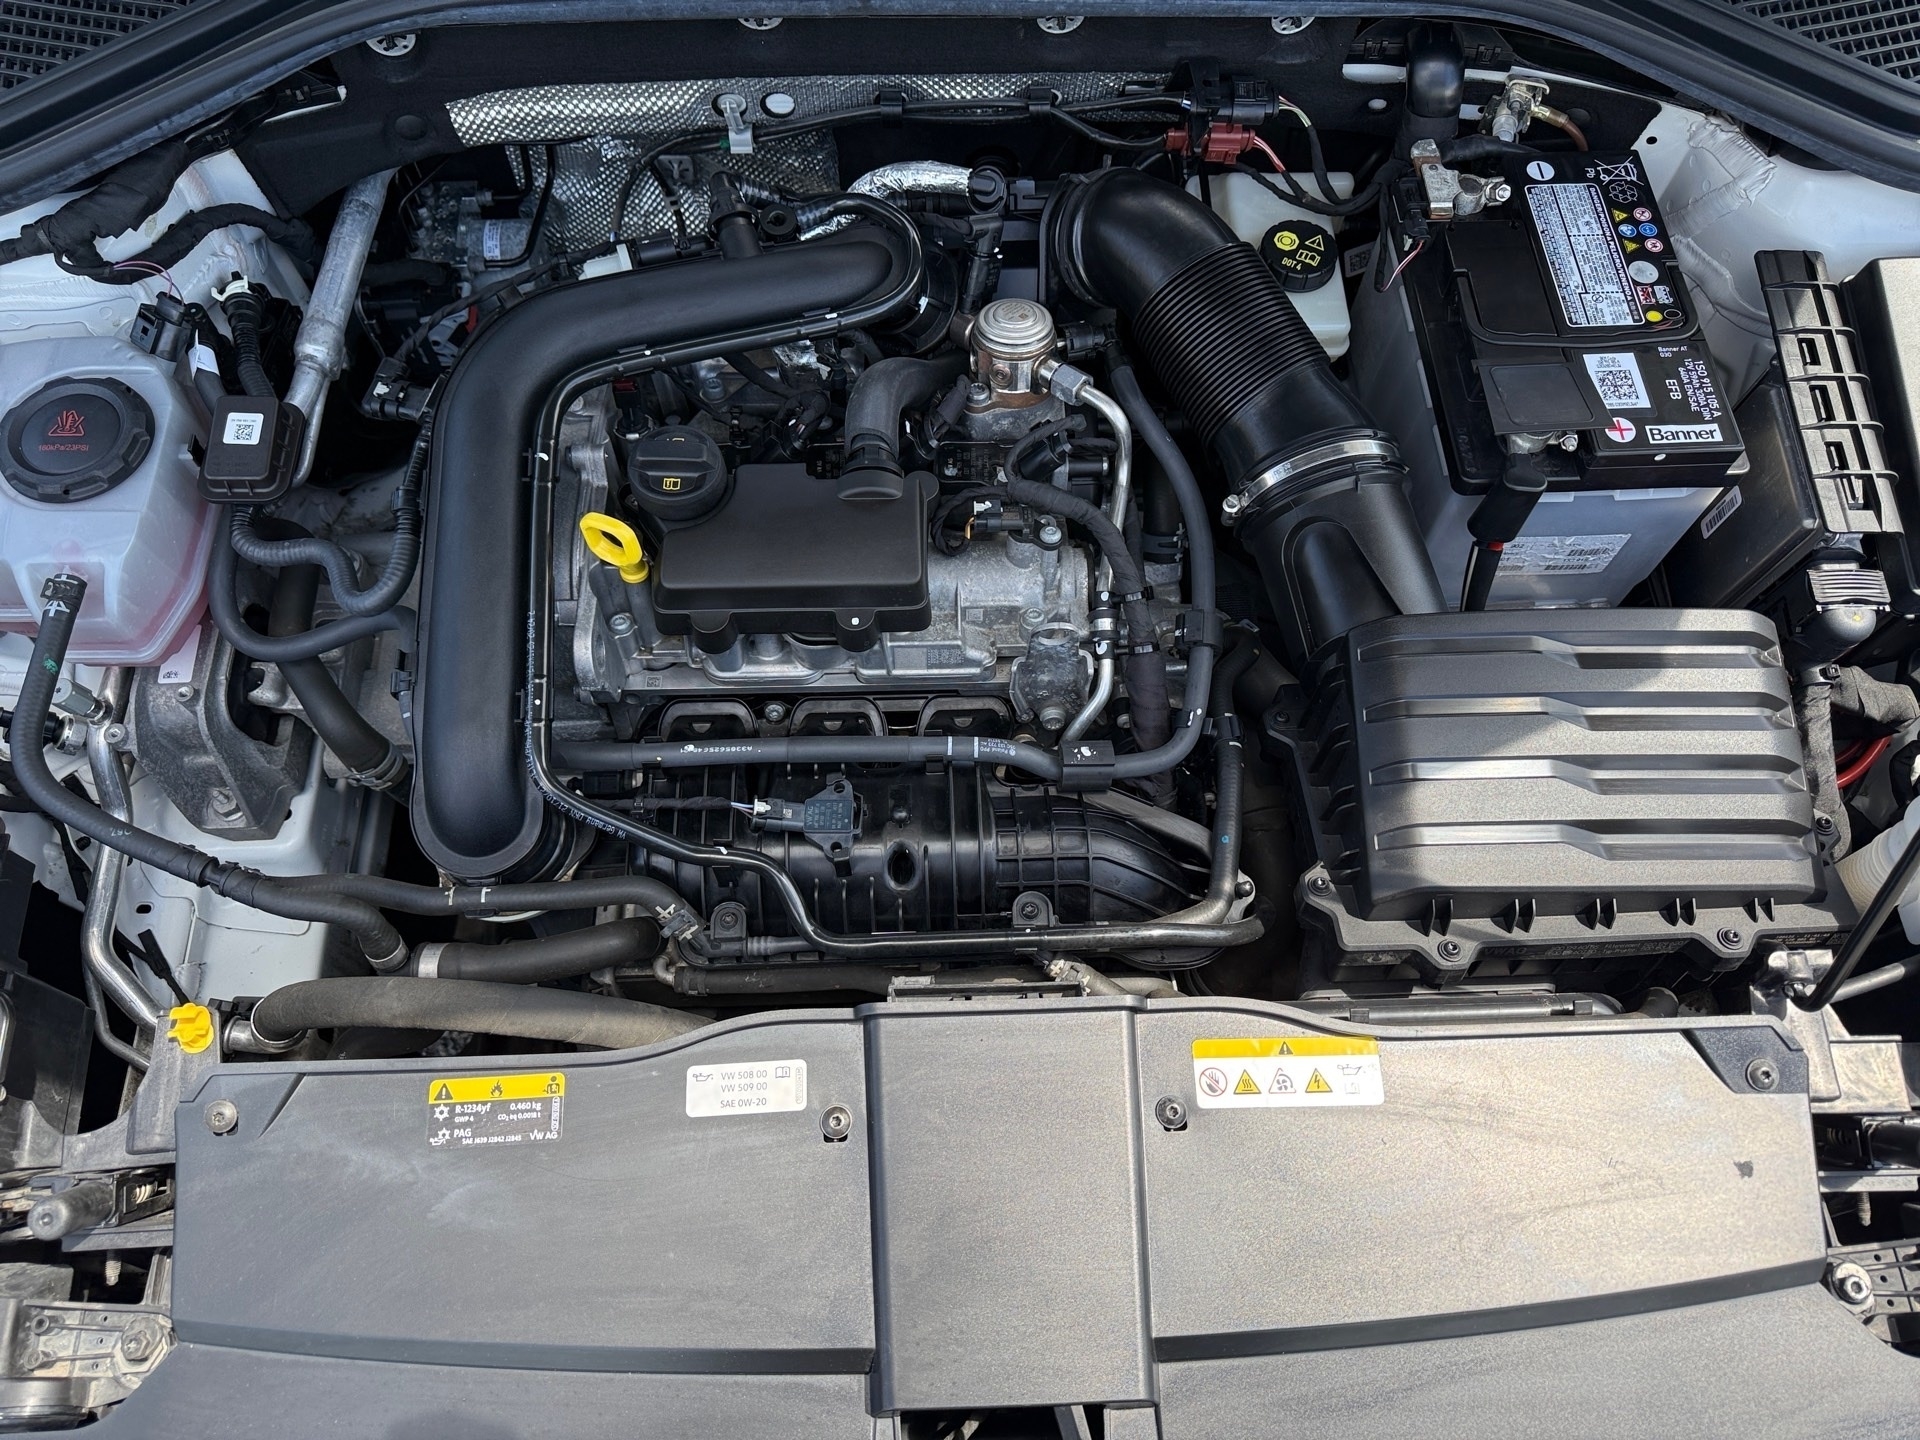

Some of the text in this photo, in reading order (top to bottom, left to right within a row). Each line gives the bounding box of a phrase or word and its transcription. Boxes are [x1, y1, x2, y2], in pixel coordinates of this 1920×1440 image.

[1584, 167, 1596, 179] Pb
[1281, 257, 1297, 268] DOT
[1666, 380, 1682, 400] EFB
[1700, 378, 1714, 393] 915
[1684, 384, 1700, 412] EN/SAE
[1706, 394, 1720, 409] 105
[1700, 407, 1713, 420] DIN
[1712, 410, 1722, 418] A
[1648, 428, 1716, 442] Banner
[586, 816, 616, 834] Germany
[721, 1070, 768, 1080] VW 508 00
[721, 1082, 768, 1092] VW 509 00
[455, 1102, 542, 1114] R-1234yf 0.460 kg
[720, 1098, 767, 1108] SAE 0W-20
[454, 1128, 472, 1138] PAG
[530, 1129, 545, 1140] VW
[545, 1131, 558, 1140] AG
